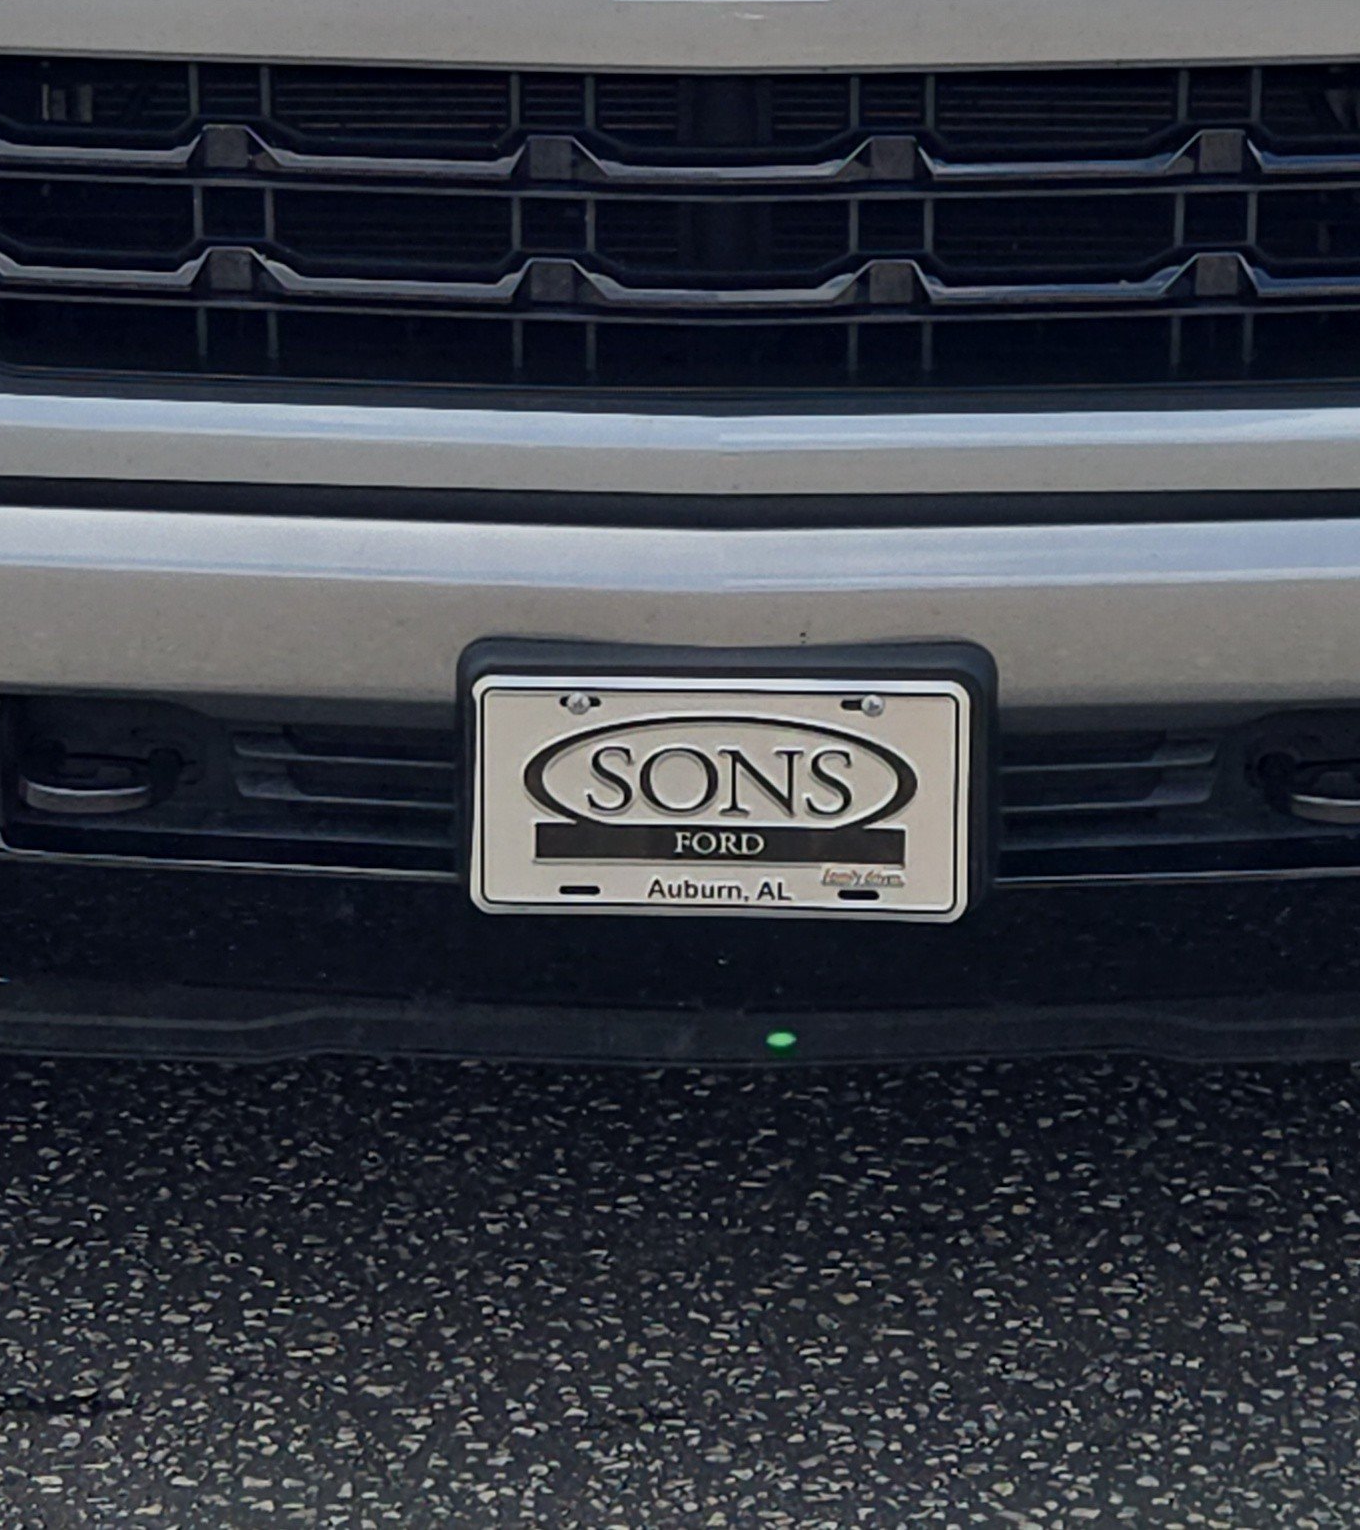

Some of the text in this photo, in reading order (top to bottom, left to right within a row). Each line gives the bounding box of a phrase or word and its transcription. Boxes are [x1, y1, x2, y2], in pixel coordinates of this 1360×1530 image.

[586, 745, 853, 819] SONS
[674, 831, 765, 856] FORD
[647, 878, 792, 902] Auburn, AL
